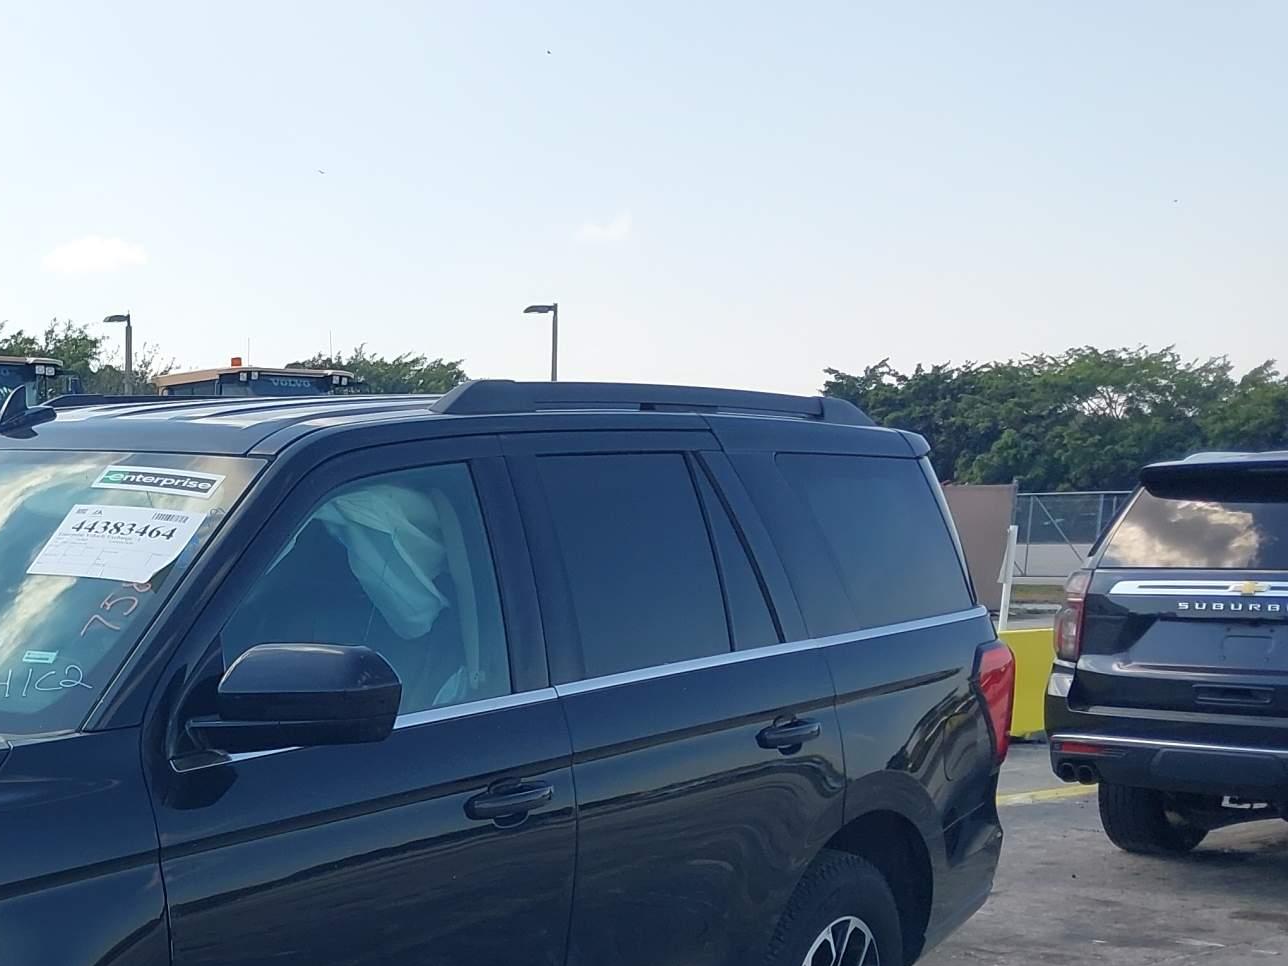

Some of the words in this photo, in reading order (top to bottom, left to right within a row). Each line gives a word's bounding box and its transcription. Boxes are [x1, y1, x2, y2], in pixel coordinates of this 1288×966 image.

[271, 378, 311, 388] VOLVO
[104, 471, 212, 490] enterprise
[72, 519, 178, 540] 44383464
[1177, 602, 1288, 612] SUBURB
